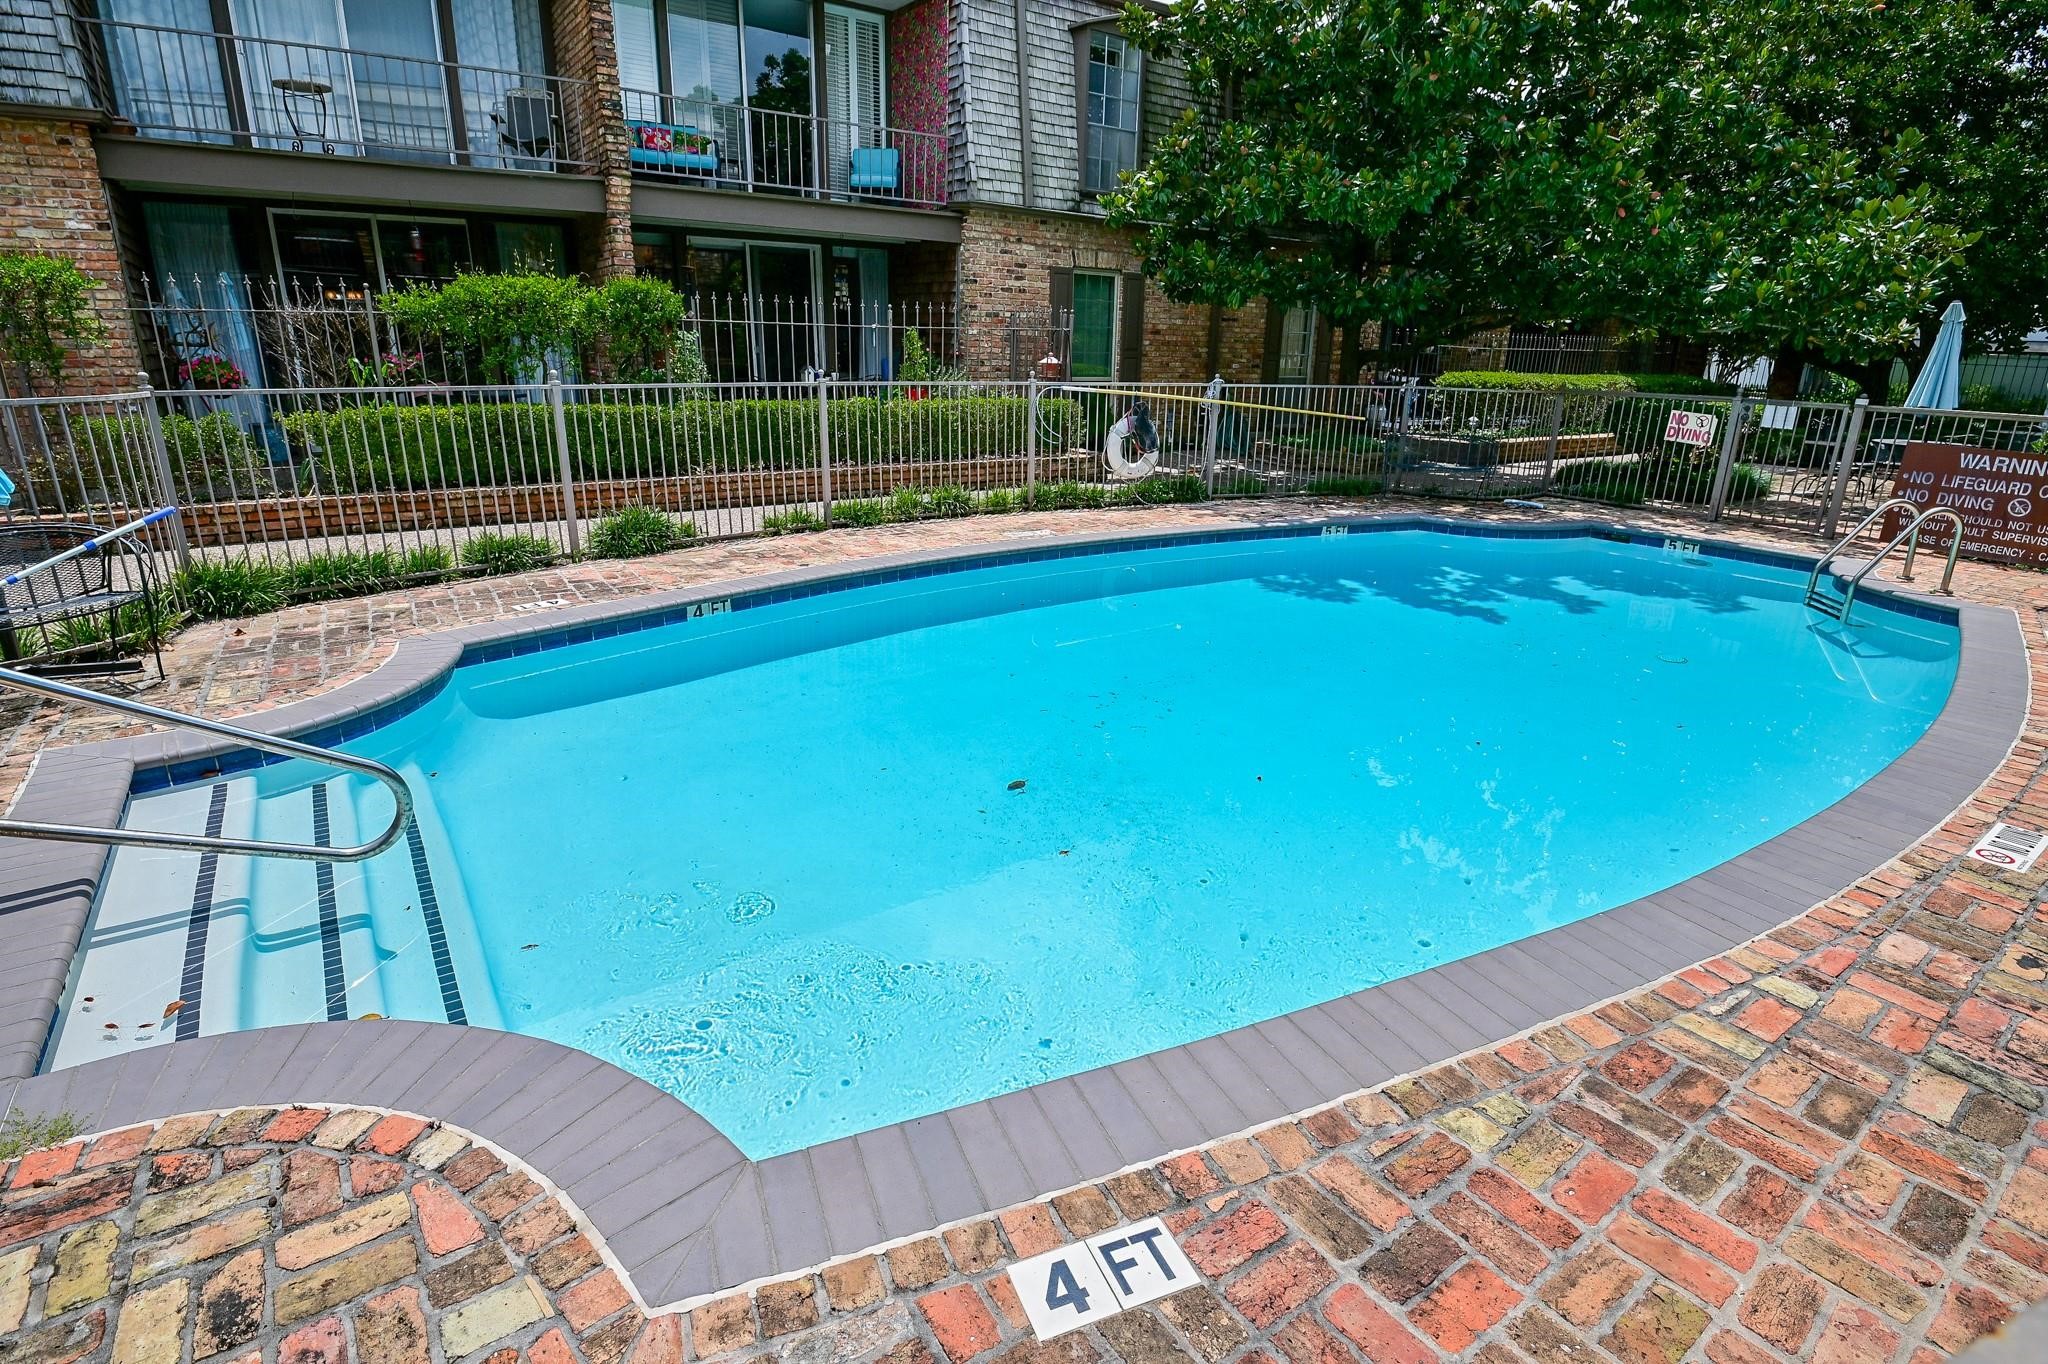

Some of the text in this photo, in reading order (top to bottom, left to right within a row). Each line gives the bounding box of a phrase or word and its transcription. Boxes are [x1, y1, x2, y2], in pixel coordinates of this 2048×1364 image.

[1670, 413, 1689, 426] NO
[1667, 426, 1711, 443] DIVING
[1960, 453, 2048, 476] WARNIN
[1910, 471, 1934, 485] NO
[1941, 474, 2032, 495] LIFEGUARD
[1904, 488, 1995, 511] NO DIVING
[1899, 518, 1947, 532] WIOUT
[1960, 514, 2003, 528] HOULD
[2007, 521, 2033, 532] NOT
[1668, 540, 1698, 553] 5 FT
[1960, 541, 2026, 558] EMERGENCY
[693, 600, 728, 618] 4 FT
[1045, 1227, 1177, 1314] 4 FT
